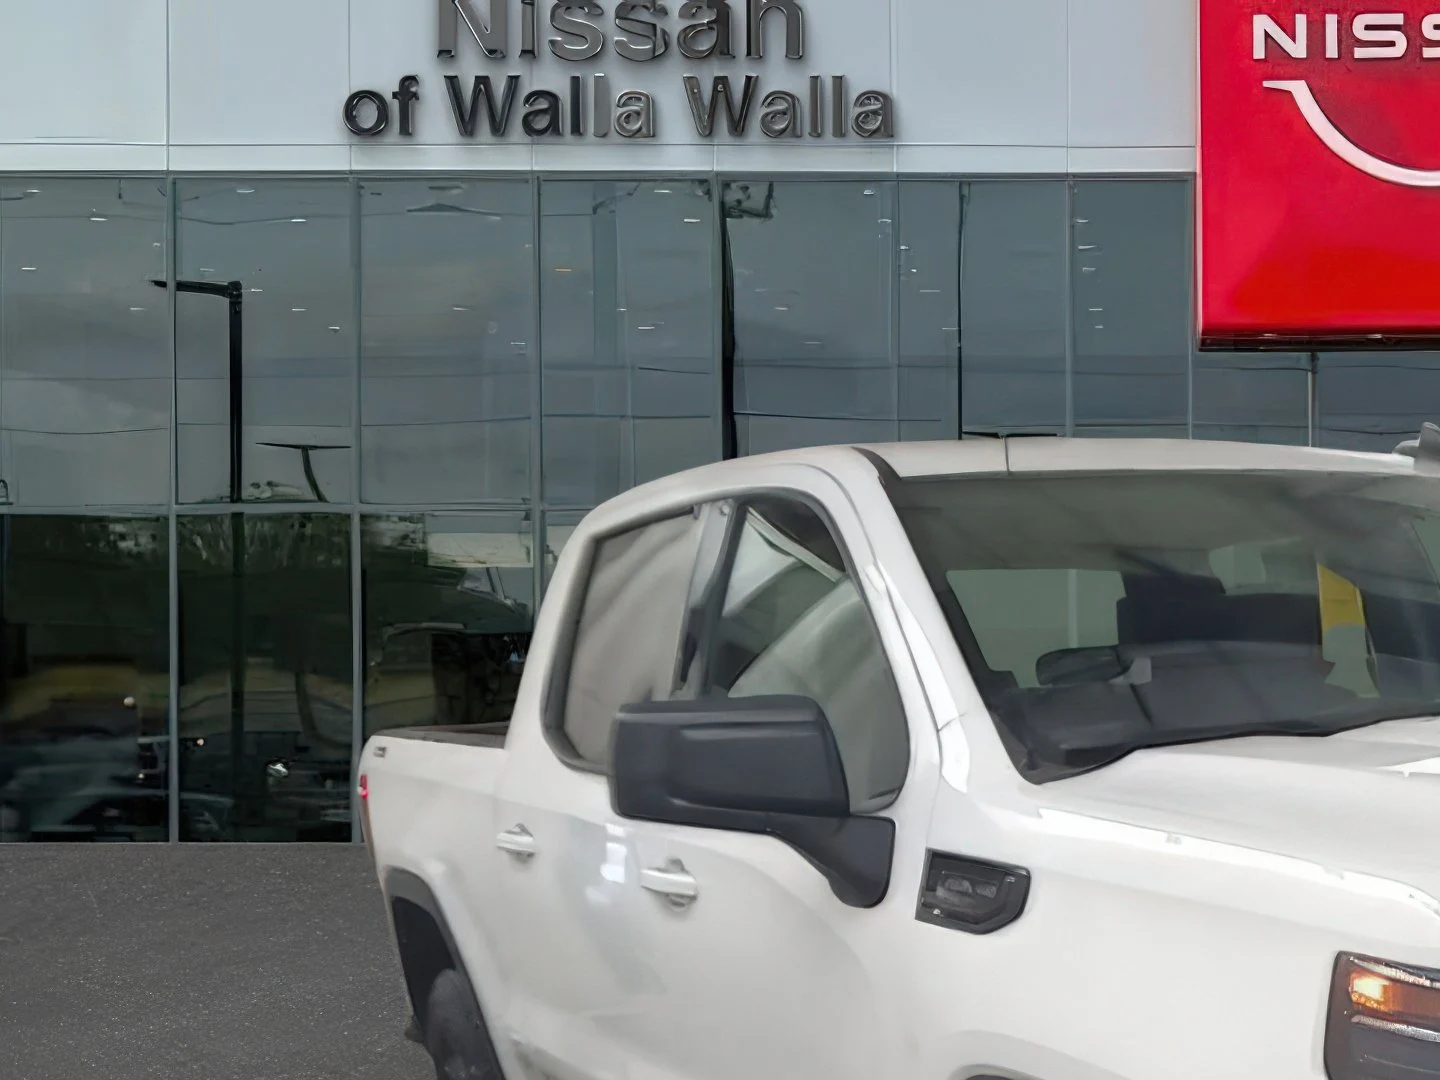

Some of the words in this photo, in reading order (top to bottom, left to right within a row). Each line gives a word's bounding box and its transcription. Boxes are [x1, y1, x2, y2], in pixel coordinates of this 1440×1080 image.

[436, 0, 804, 61] Nissan
[341, 74, 421, 137] of
[443, 74, 655, 137] Walla
[682, 74, 894, 137] Walla
